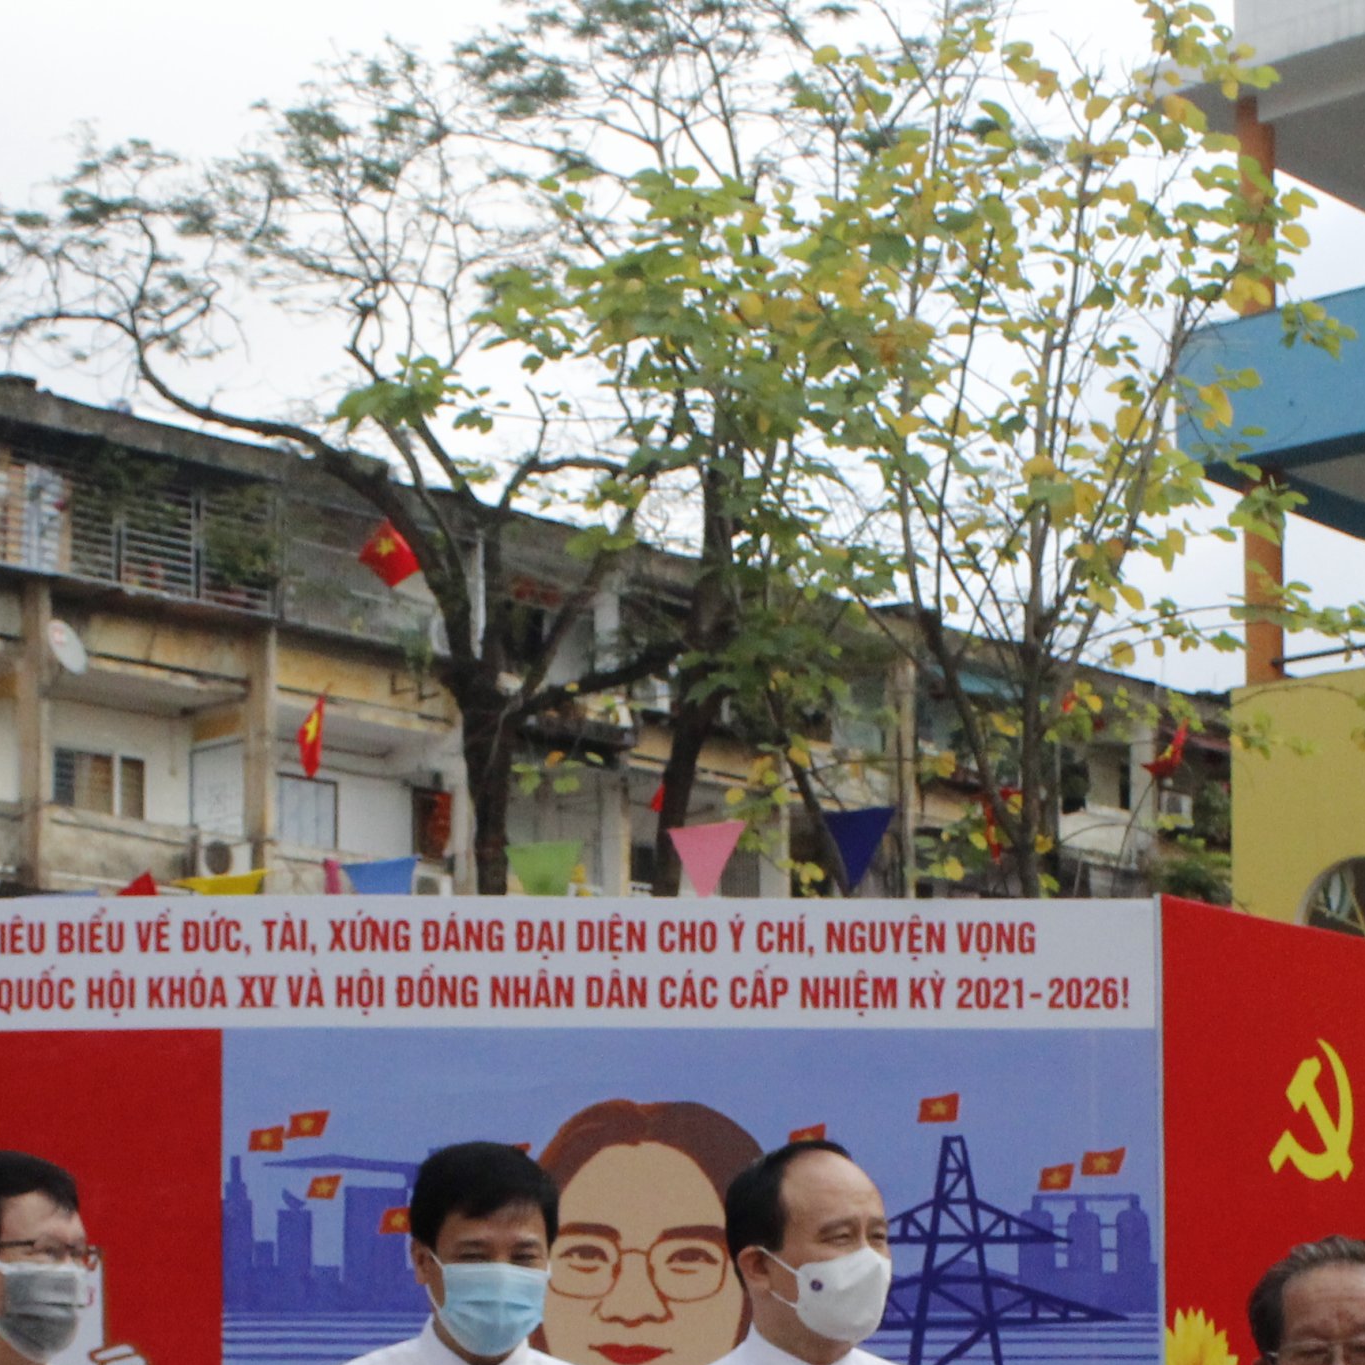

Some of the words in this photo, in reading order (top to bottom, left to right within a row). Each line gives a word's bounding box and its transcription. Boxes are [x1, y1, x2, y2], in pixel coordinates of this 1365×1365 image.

[57, 907, 125, 954] BIỂU
[136, 909, 170, 953] VỀ
[182, 910, 252, 956] ĐỨC,
[262, 912, 317, 955] TÀI,
[329, 911, 411, 952] XỨNG
[422, 912, 506, 952] ĐÁNG
[515, 919, 566, 960] ĐẠI
[577, 913, 647, 960] DIỆN
[658, 920, 718, 953] CHO
[729, 914, 745, 953] Ý
[756, 914, 815, 957] CHÍ,
[826, 914, 946, 961] NGUYỆN
[956, 921, 1036, 961] VỌNG
[88, 970, 136, 1017] HỘI
[147, 968, 227, 1009] KHÓA
[238, 975, 278, 1009] XV
[288, 968, 325, 1008] VÀ
[335, 968, 385, 1015] HỘI
[395, 964, 480, 1008] ĐỒNG
[490, 968, 574, 1008] NHÂN
[586, 968, 648, 1008] DÂN
[658, 968, 719, 1009] CÁC
[729, 964, 790, 1009] CẤP
[800, 969, 898, 1016] NHIỆM
[909, 970, 946, 1009] KỲ
